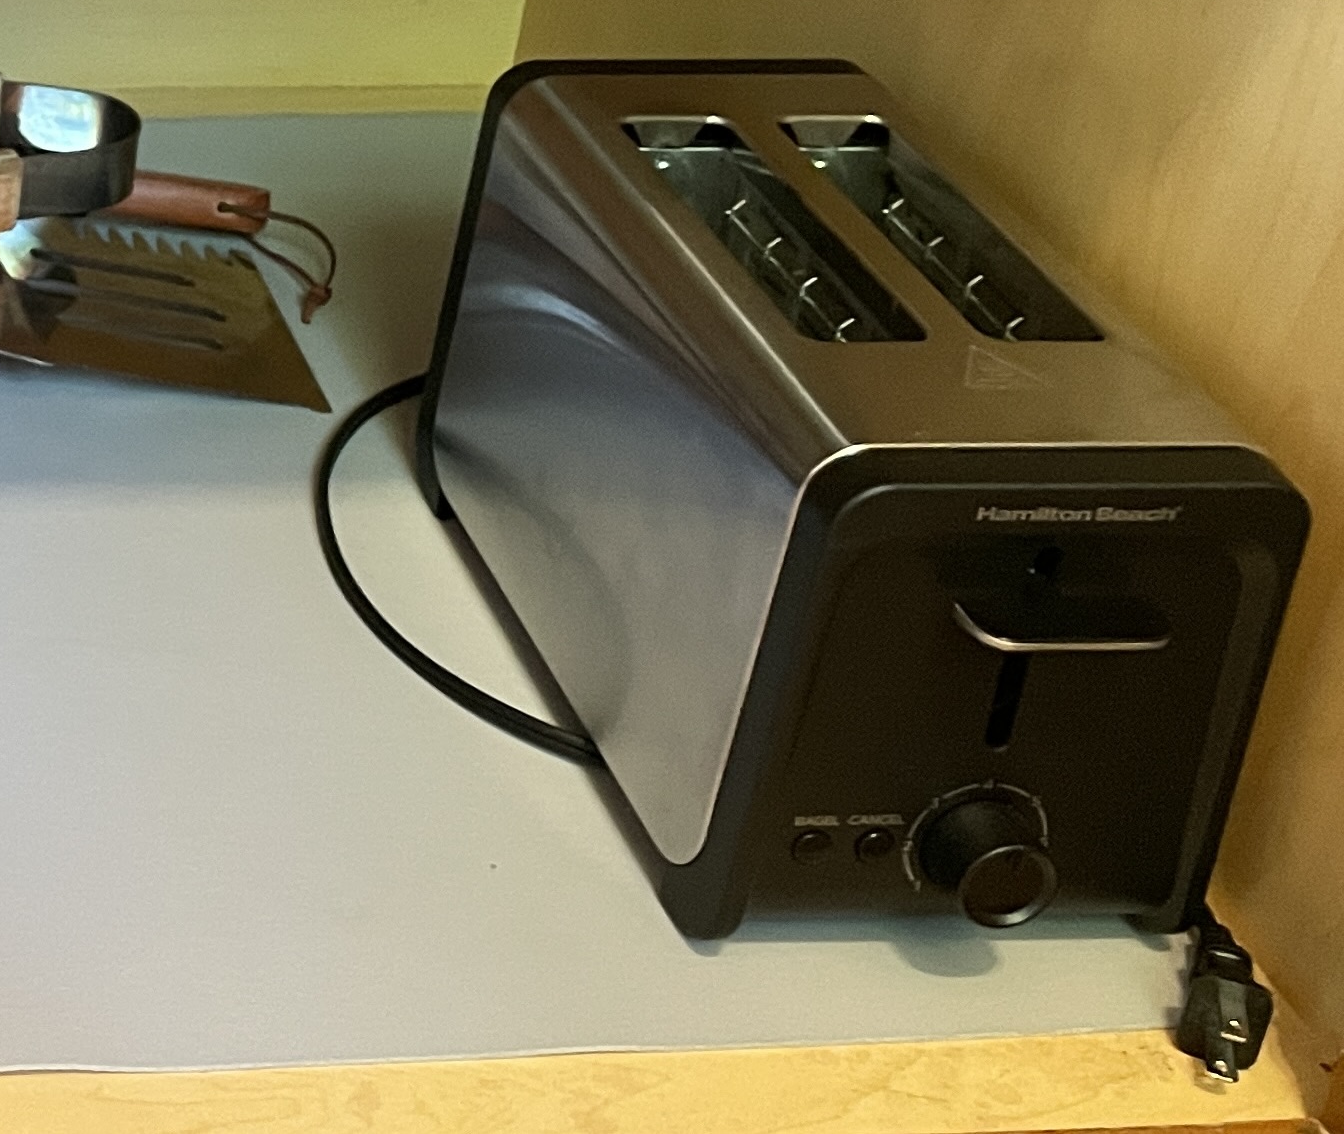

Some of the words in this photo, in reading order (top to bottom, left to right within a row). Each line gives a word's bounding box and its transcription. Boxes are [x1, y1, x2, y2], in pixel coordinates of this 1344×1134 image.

[976, 506, 1092, 522] Hamilton
[1095, 506, 1179, 523] Beach
[794, 815, 840, 826] BAGEL
[846, 814, 906, 826] CANCEL
